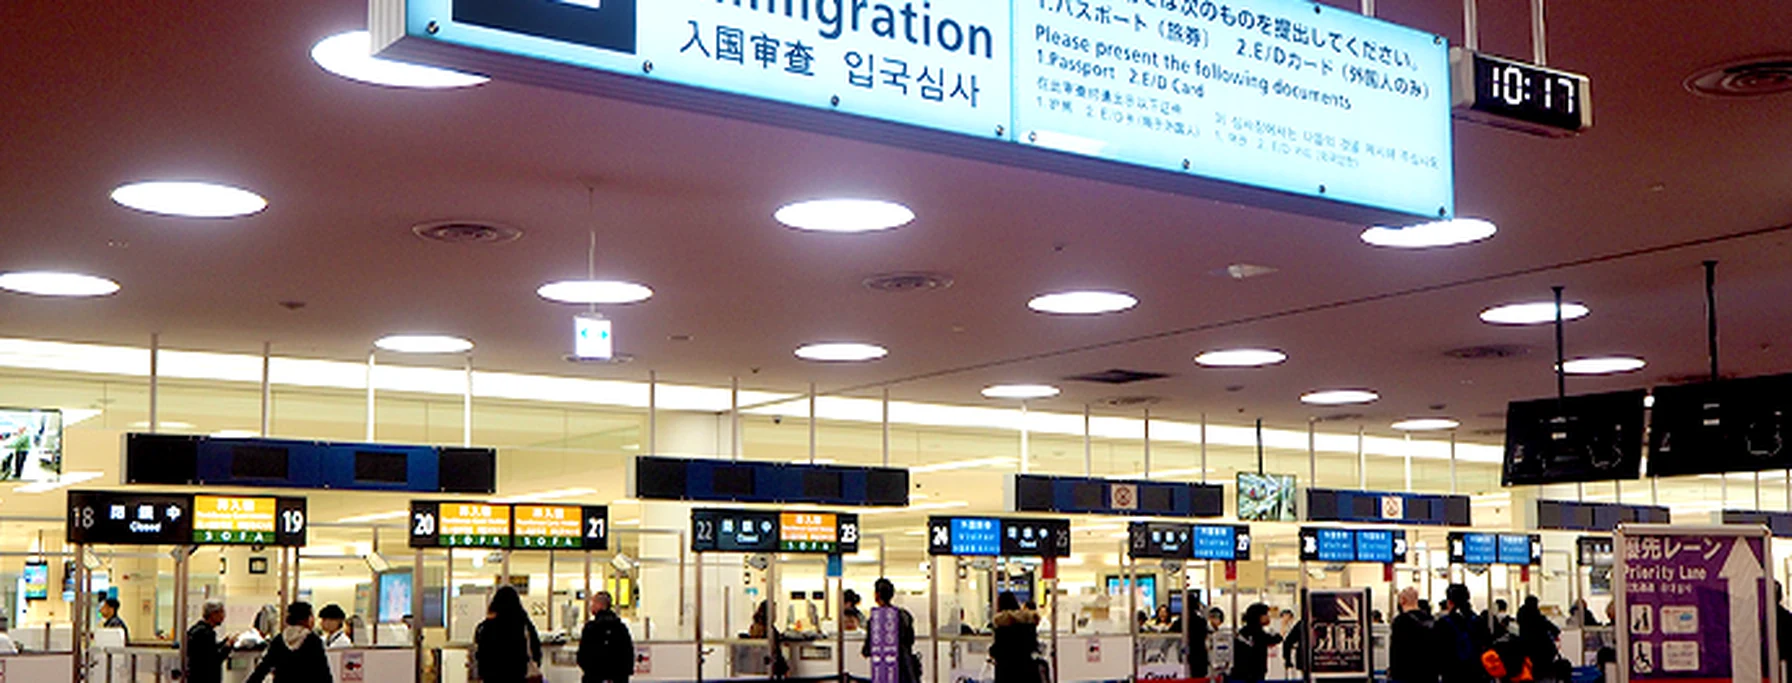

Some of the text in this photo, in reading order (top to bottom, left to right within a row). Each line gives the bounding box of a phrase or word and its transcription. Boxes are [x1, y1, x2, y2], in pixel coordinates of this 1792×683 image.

[1035, 24, 1352, 110] Please present the following documents
[844, 51, 980, 108] 입국심사
[1171, 77, 1205, 98] Card
[1492, 67, 1575, 113] 10:17
[73, 506, 94, 529] 18
[282, 510, 304, 533] 19
[413, 513, 435, 536] 20
[587, 517, 605, 539] 21
[696, 521, 713, 541] 22
[841, 523, 858, 543] 23
[1680, 565, 1707, 580] Lane
